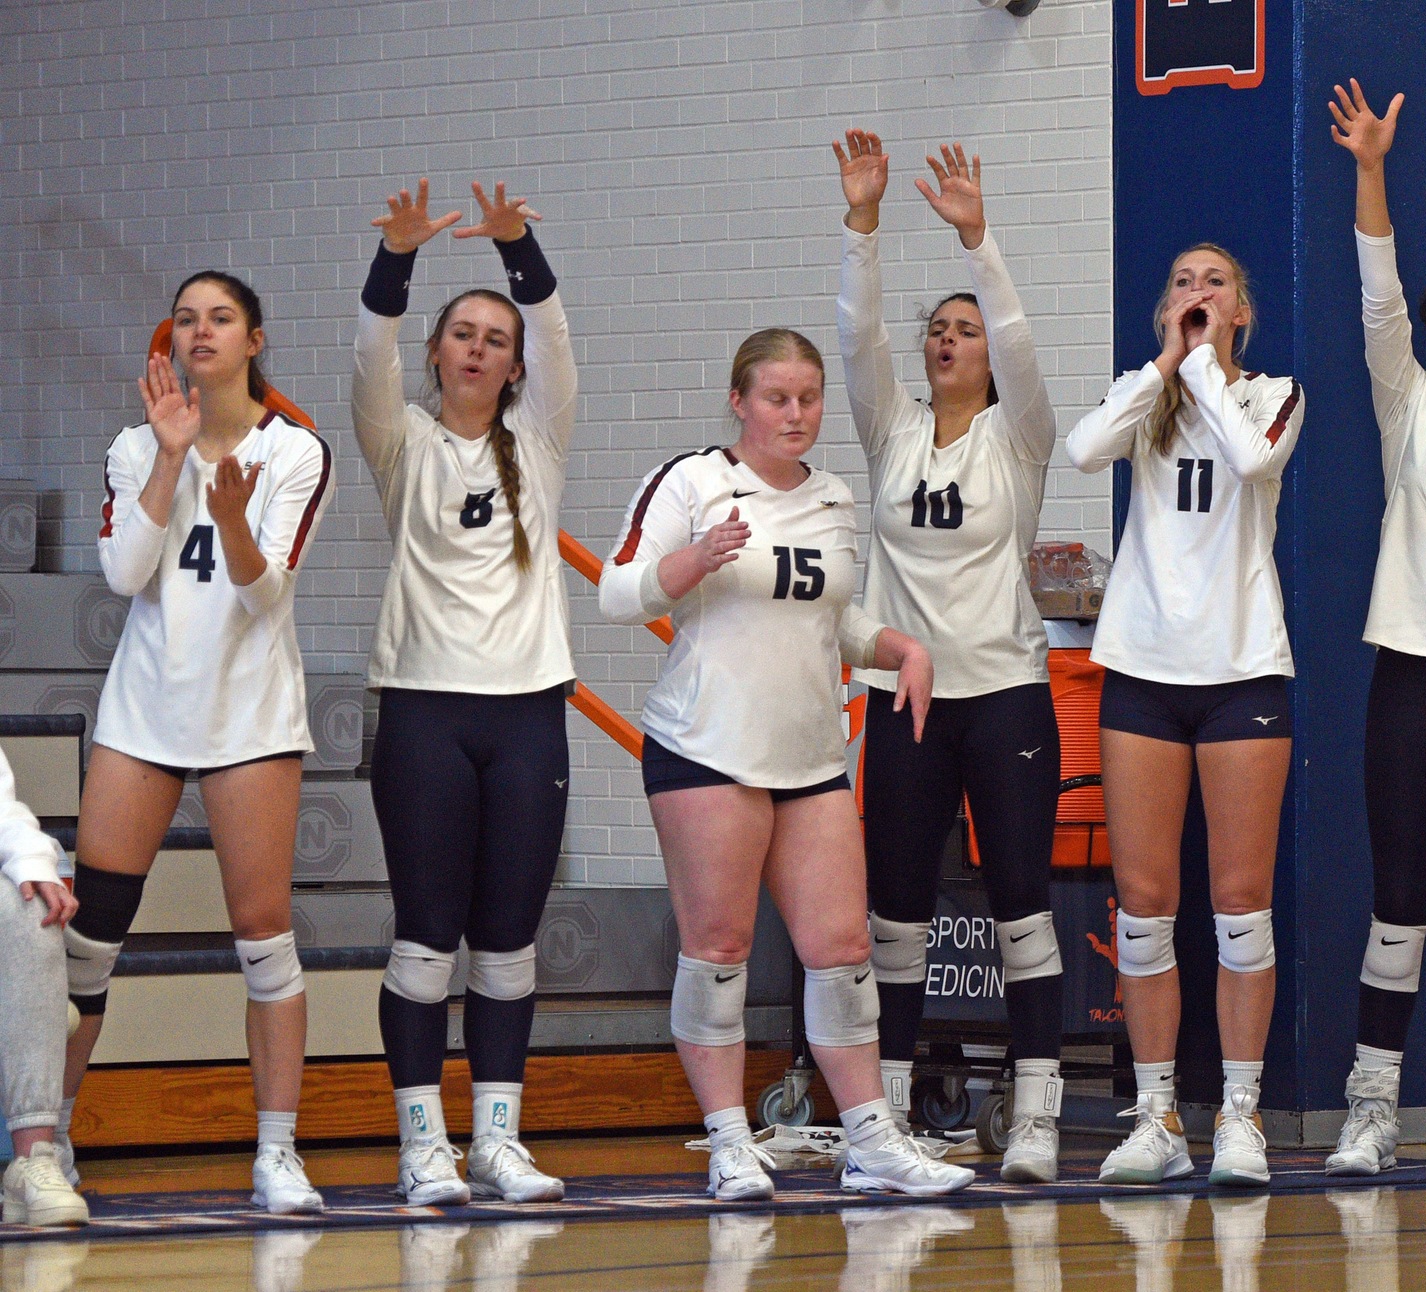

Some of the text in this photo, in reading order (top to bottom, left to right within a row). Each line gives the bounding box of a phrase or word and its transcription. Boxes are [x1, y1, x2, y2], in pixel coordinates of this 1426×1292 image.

[459, 488, 496, 529] 8
[911, 479, 963, 529] 10
[1177, 458, 1213, 513] 11
[179, 524, 215, 582] 4
[772, 546, 825, 601] 15
[925, 963, 1005, 998] EDICIN
